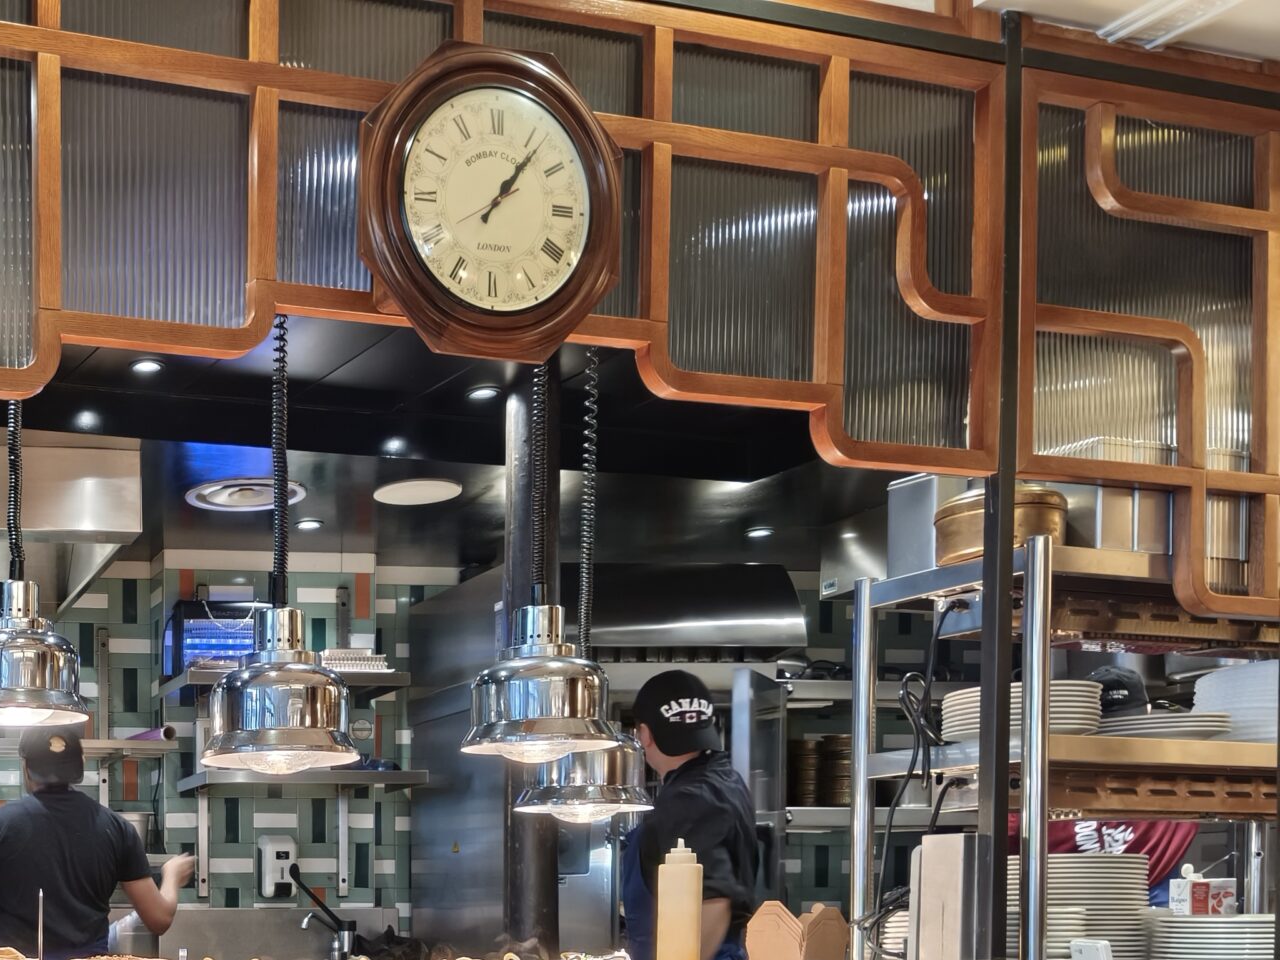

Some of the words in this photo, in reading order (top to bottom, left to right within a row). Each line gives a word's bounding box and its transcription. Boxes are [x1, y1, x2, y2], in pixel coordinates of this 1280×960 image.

[465, 150, 499, 167] BOMBAY
[552, 204, 574, 219] III
[476, 242, 512, 253] LONDON
[660, 697, 713, 717] CANADA
